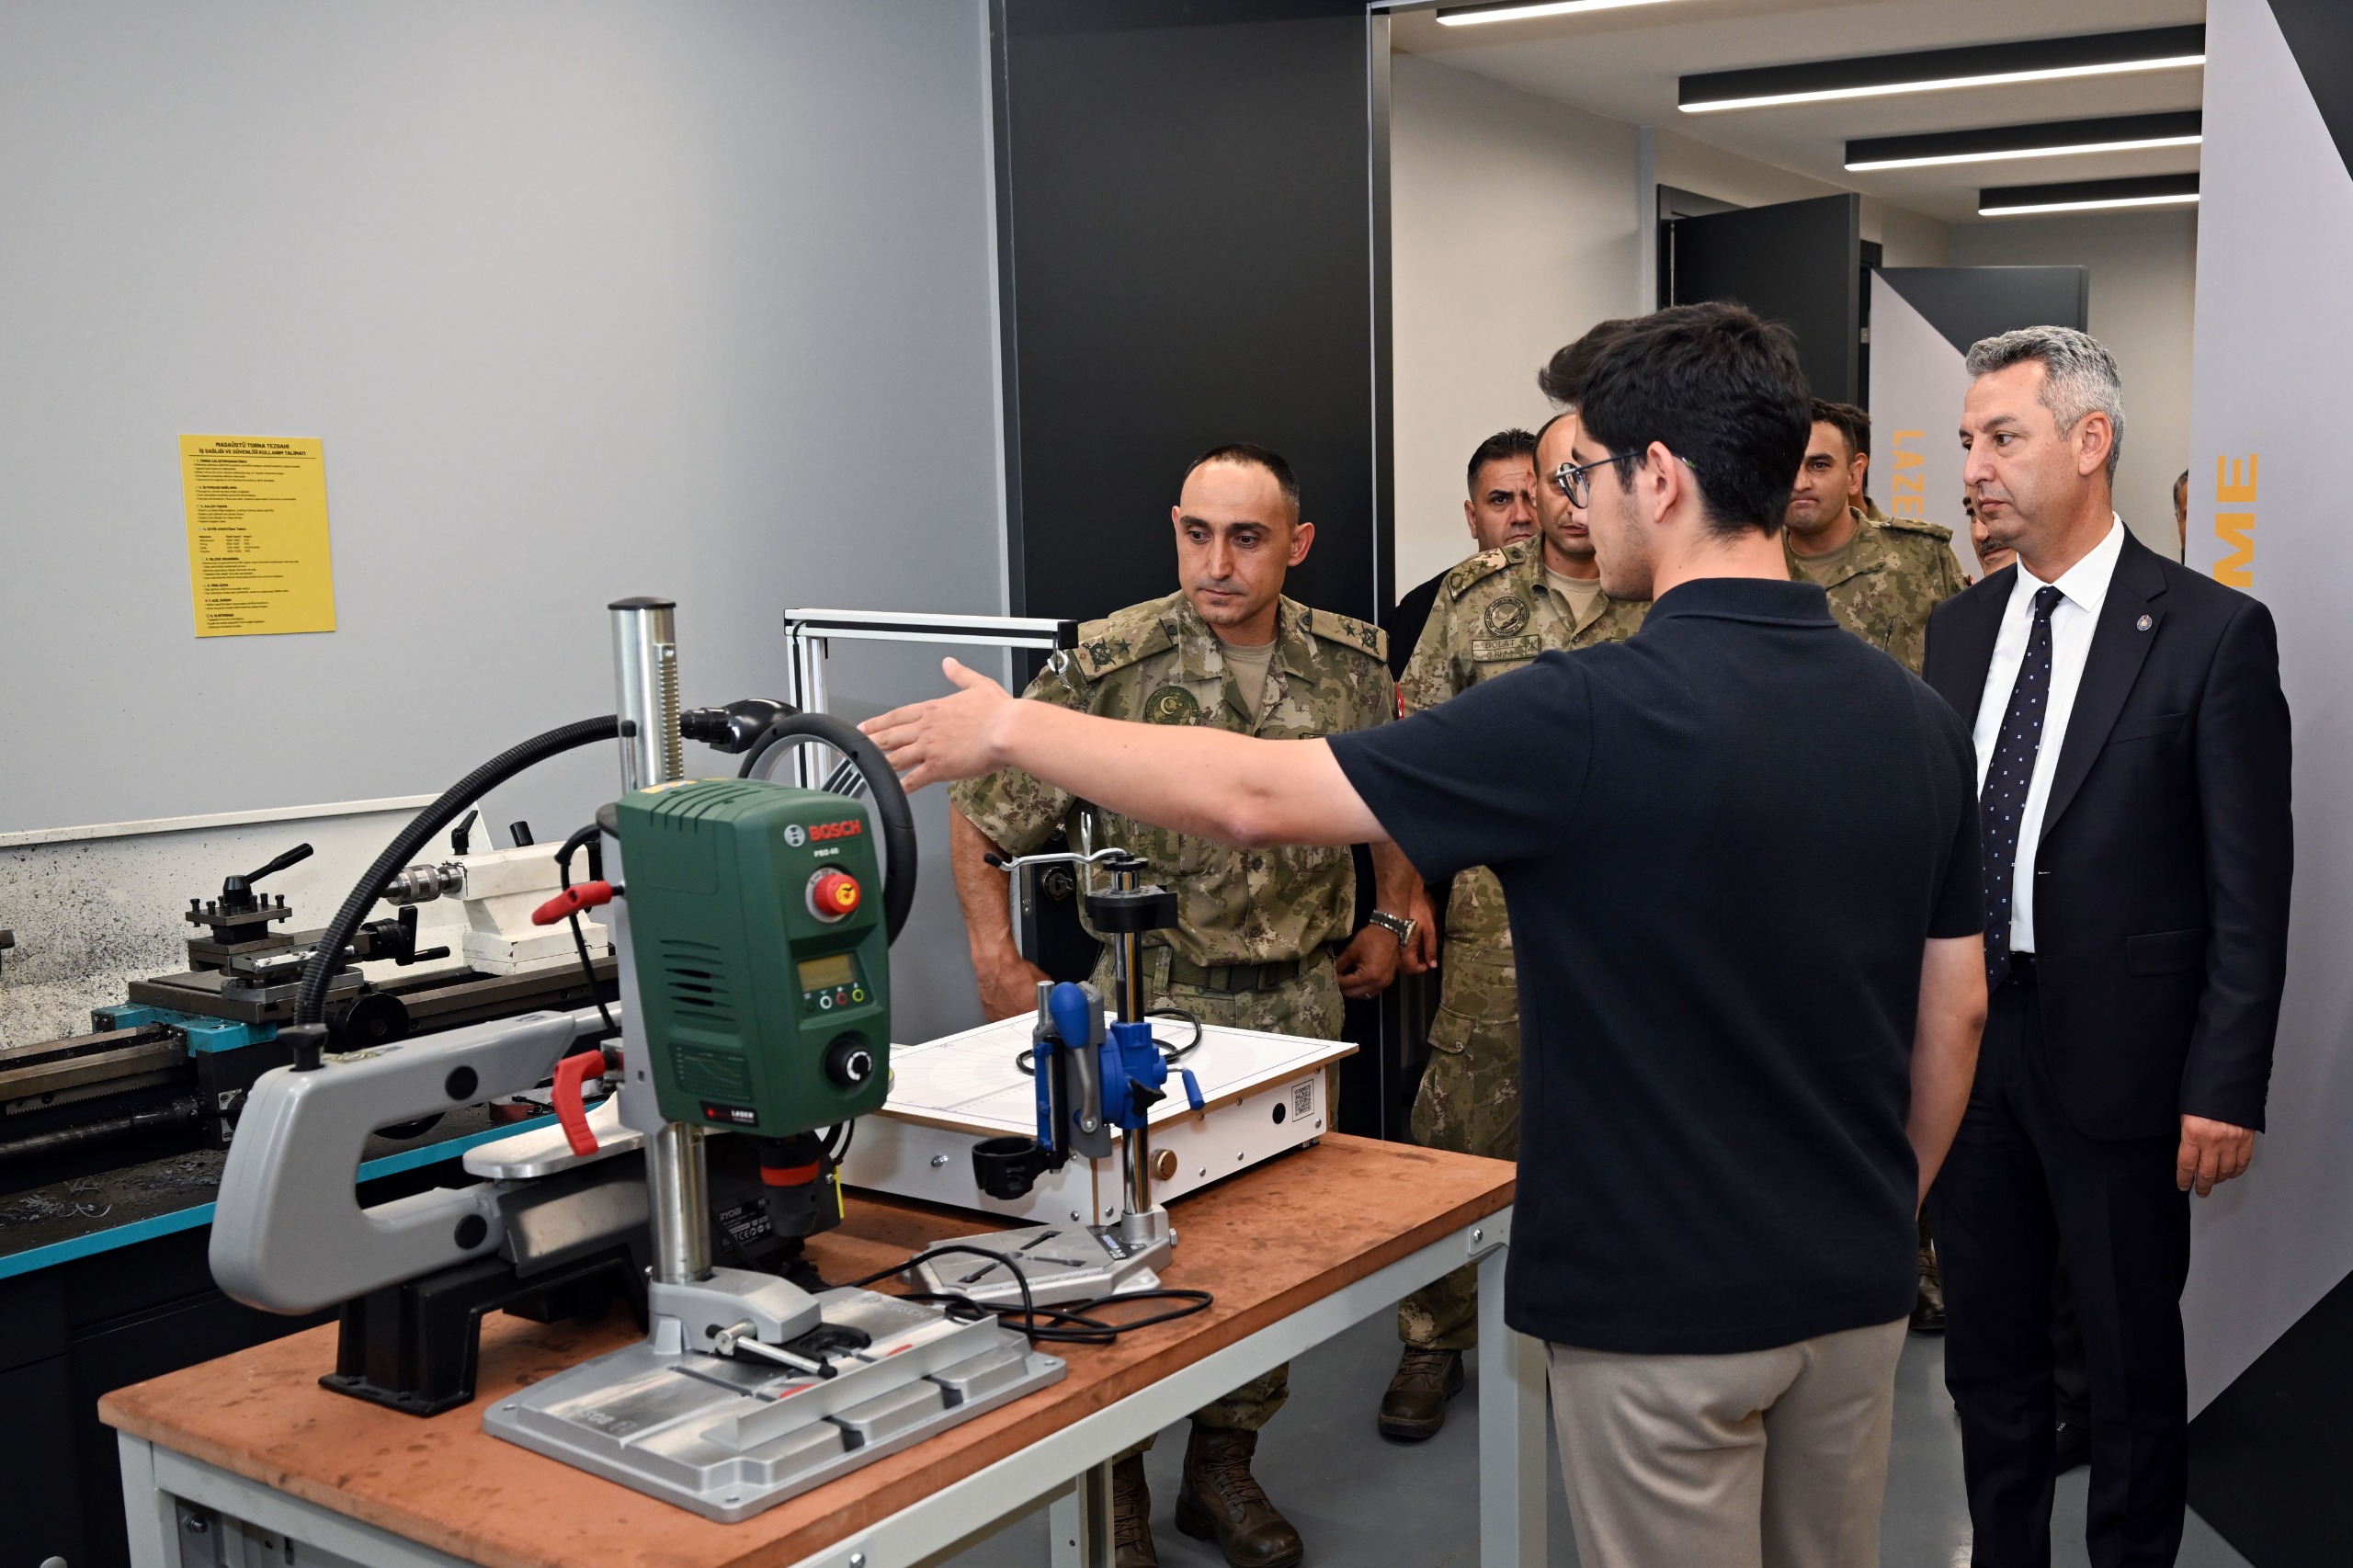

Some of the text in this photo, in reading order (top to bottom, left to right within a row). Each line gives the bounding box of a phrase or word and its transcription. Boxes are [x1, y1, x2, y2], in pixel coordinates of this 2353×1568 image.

[1893, 430, 1925, 521] LAZE
[1485, 640, 1516, 649] BOLAT
[809, 819, 862, 842] BOSCH
[732, 1109, 754, 1119] LASER
[719, 1207, 742, 1221] RYOBI
